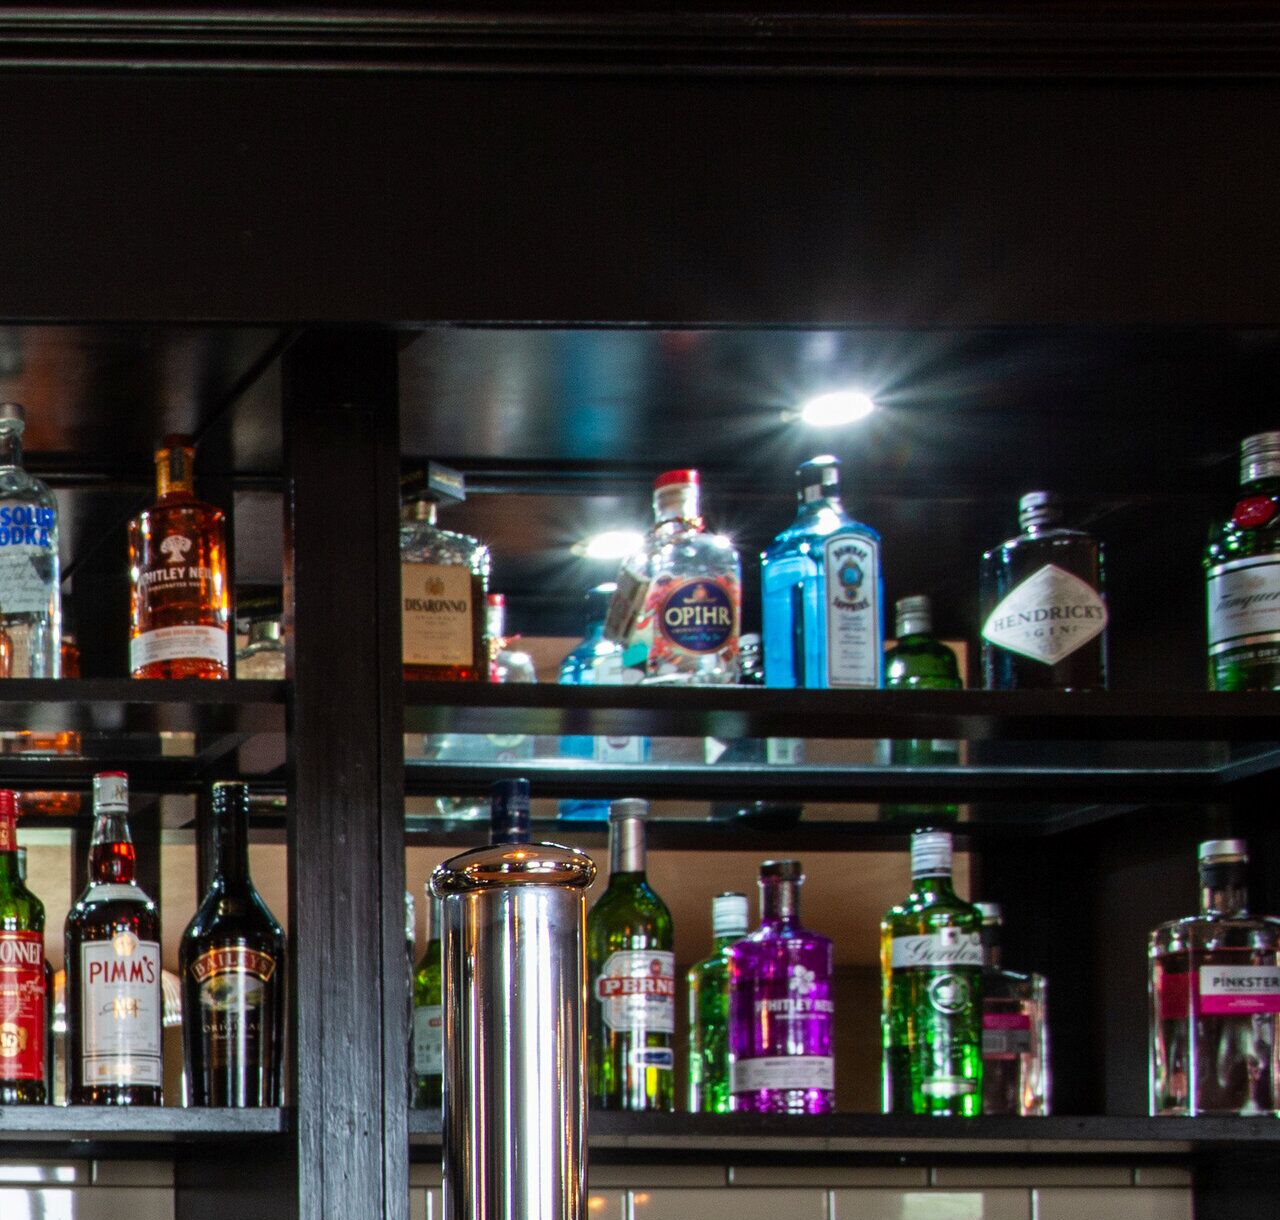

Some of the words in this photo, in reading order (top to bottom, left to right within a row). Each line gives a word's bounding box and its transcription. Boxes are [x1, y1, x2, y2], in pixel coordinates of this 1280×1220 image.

[405, 598, 467, 612] DISARONNO
[666, 606, 732, 626] OPIHR
[994, 605, 1104, 632] HENDRICK'S
[89, 956, 155, 985] PIMM'S
[195, 957, 269, 976] BAILEYS
[1212, 975, 1279, 988] PINKSTER
